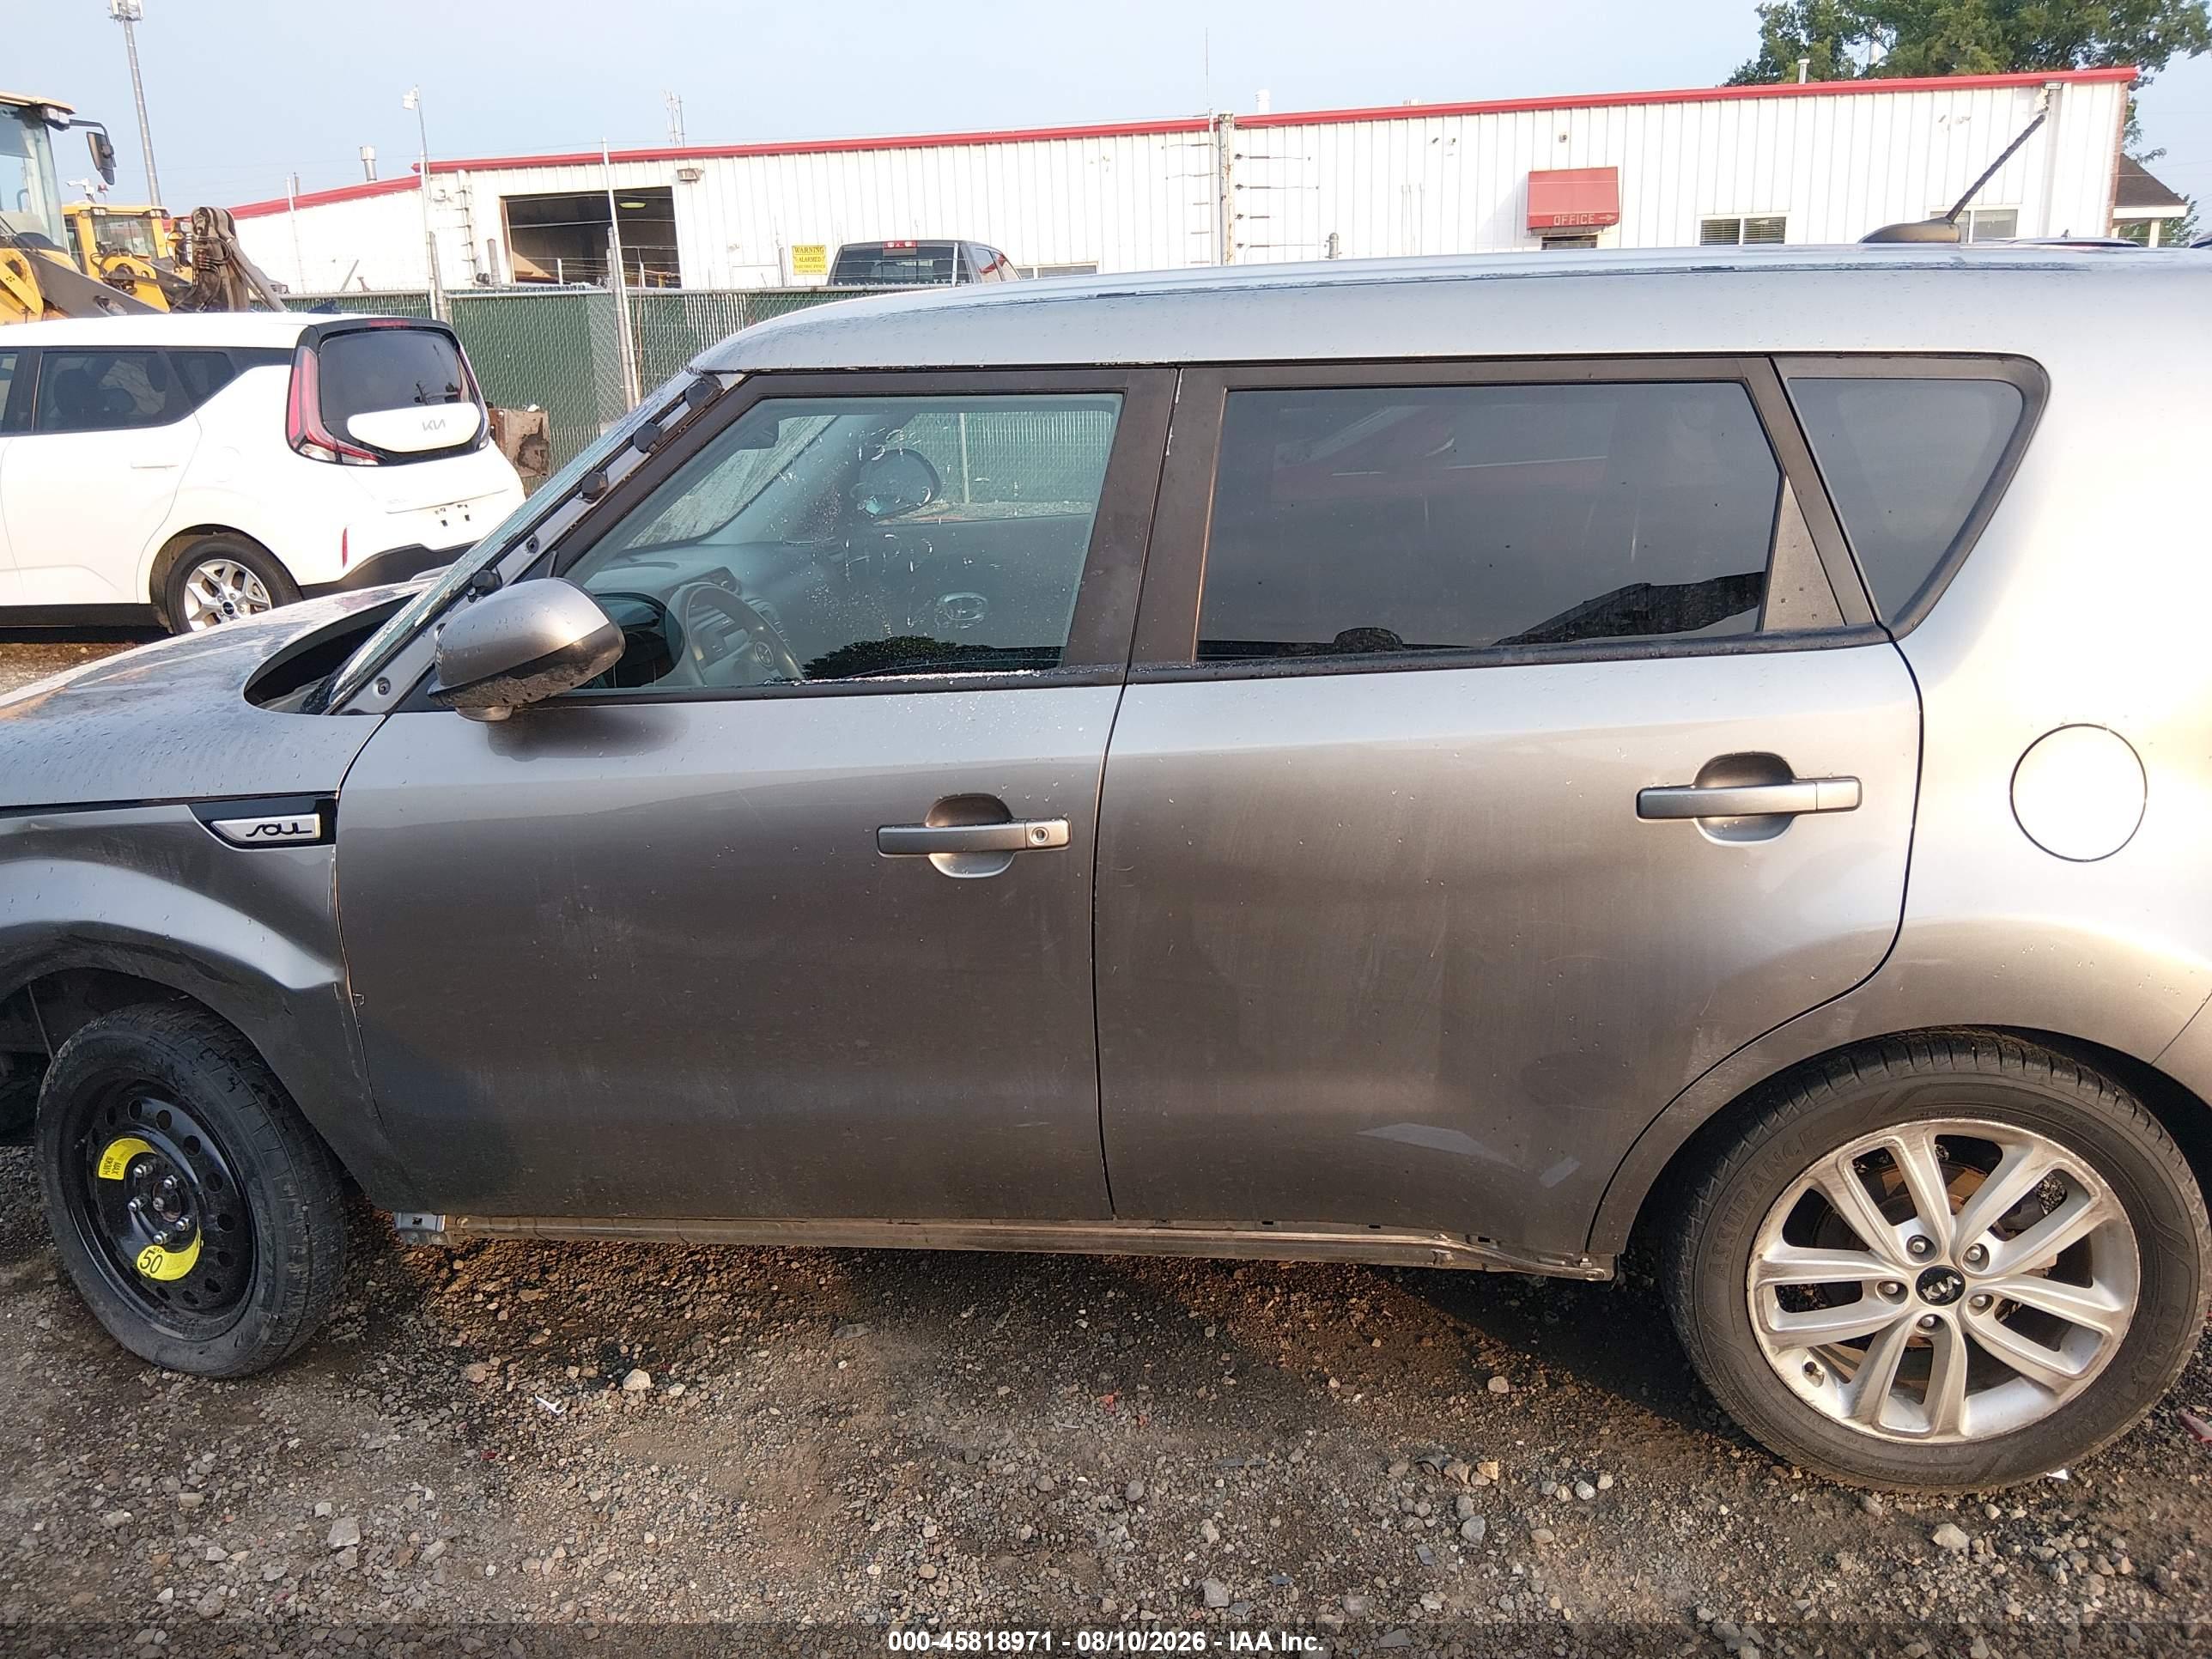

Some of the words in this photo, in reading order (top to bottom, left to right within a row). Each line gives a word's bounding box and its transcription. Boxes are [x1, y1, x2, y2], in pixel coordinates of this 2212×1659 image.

[1553, 214, 1595, 225] OFFICE
[245, 822, 313, 838] SOUL
[139, 1250, 164, 1274] 50
[1921, 1274, 1962, 1301] KIA
